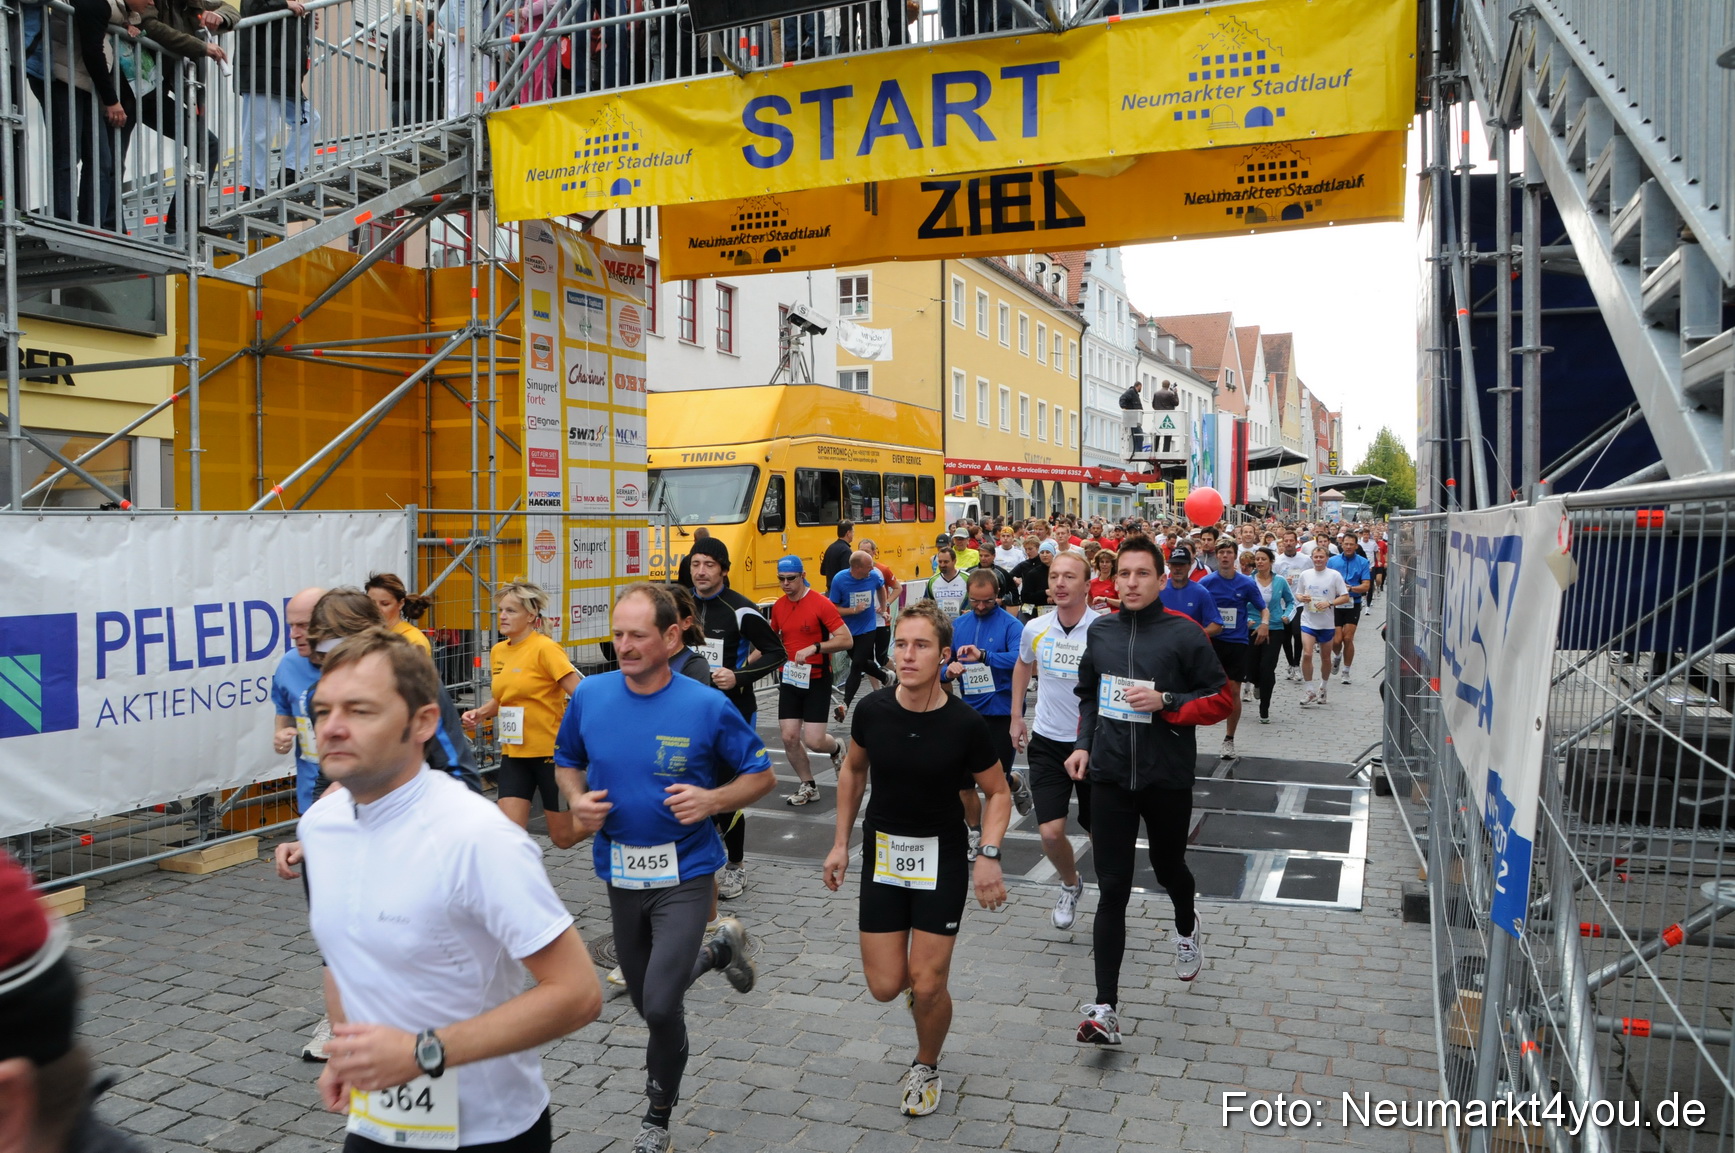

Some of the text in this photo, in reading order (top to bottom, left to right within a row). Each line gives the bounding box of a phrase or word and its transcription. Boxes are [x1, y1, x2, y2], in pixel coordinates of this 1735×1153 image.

[1120, 67, 1353, 112] Neumarkter Stadtlauf
[742, 60, 1061, 169] START
[525, 148, 694, 183] Neumarkter Stadtlauf
[1183, 173, 1366, 206] Neumarkter Stadtlauf
[917, 169, 1086, 240] ZIEL
[688, 224, 832, 250] Neumarkter Stadtlauf
[604, 259, 646, 280] MERZ
[533, 310, 550, 320] KANN
[526, 377, 558, 394] Sinupret
[614, 373, 647, 393] OBI
[526, 393, 546, 406] forte
[615, 427, 638, 444] MCM
[681, 450, 737, 463] TIMING
[817, 445, 847, 457] SPORTRONIC
[892, 454, 922, 466] EVENT SERVICE
[958, 462, 982, 470] Service
[1050, 468, 1067, 476] 09181
[1067, 469, 1082, 477] 6352
[534, 490, 561, 498] INTERSPORT
[528, 498, 561, 507] HACKNER
[573, 538, 608, 555] Sinupret
[573, 556, 594, 570] forte
[1055, 641, 1079, 651] Manfred
[1054, 652, 1082, 666] 2025
[969, 673, 990, 684] 2286
[1114, 676, 1136, 688] Tobias
[95, 674, 276, 729] AKTIENGES
[890, 840, 925, 852] Andreas
[626, 853, 669, 871] 2455
[896, 857, 925, 872] 891
